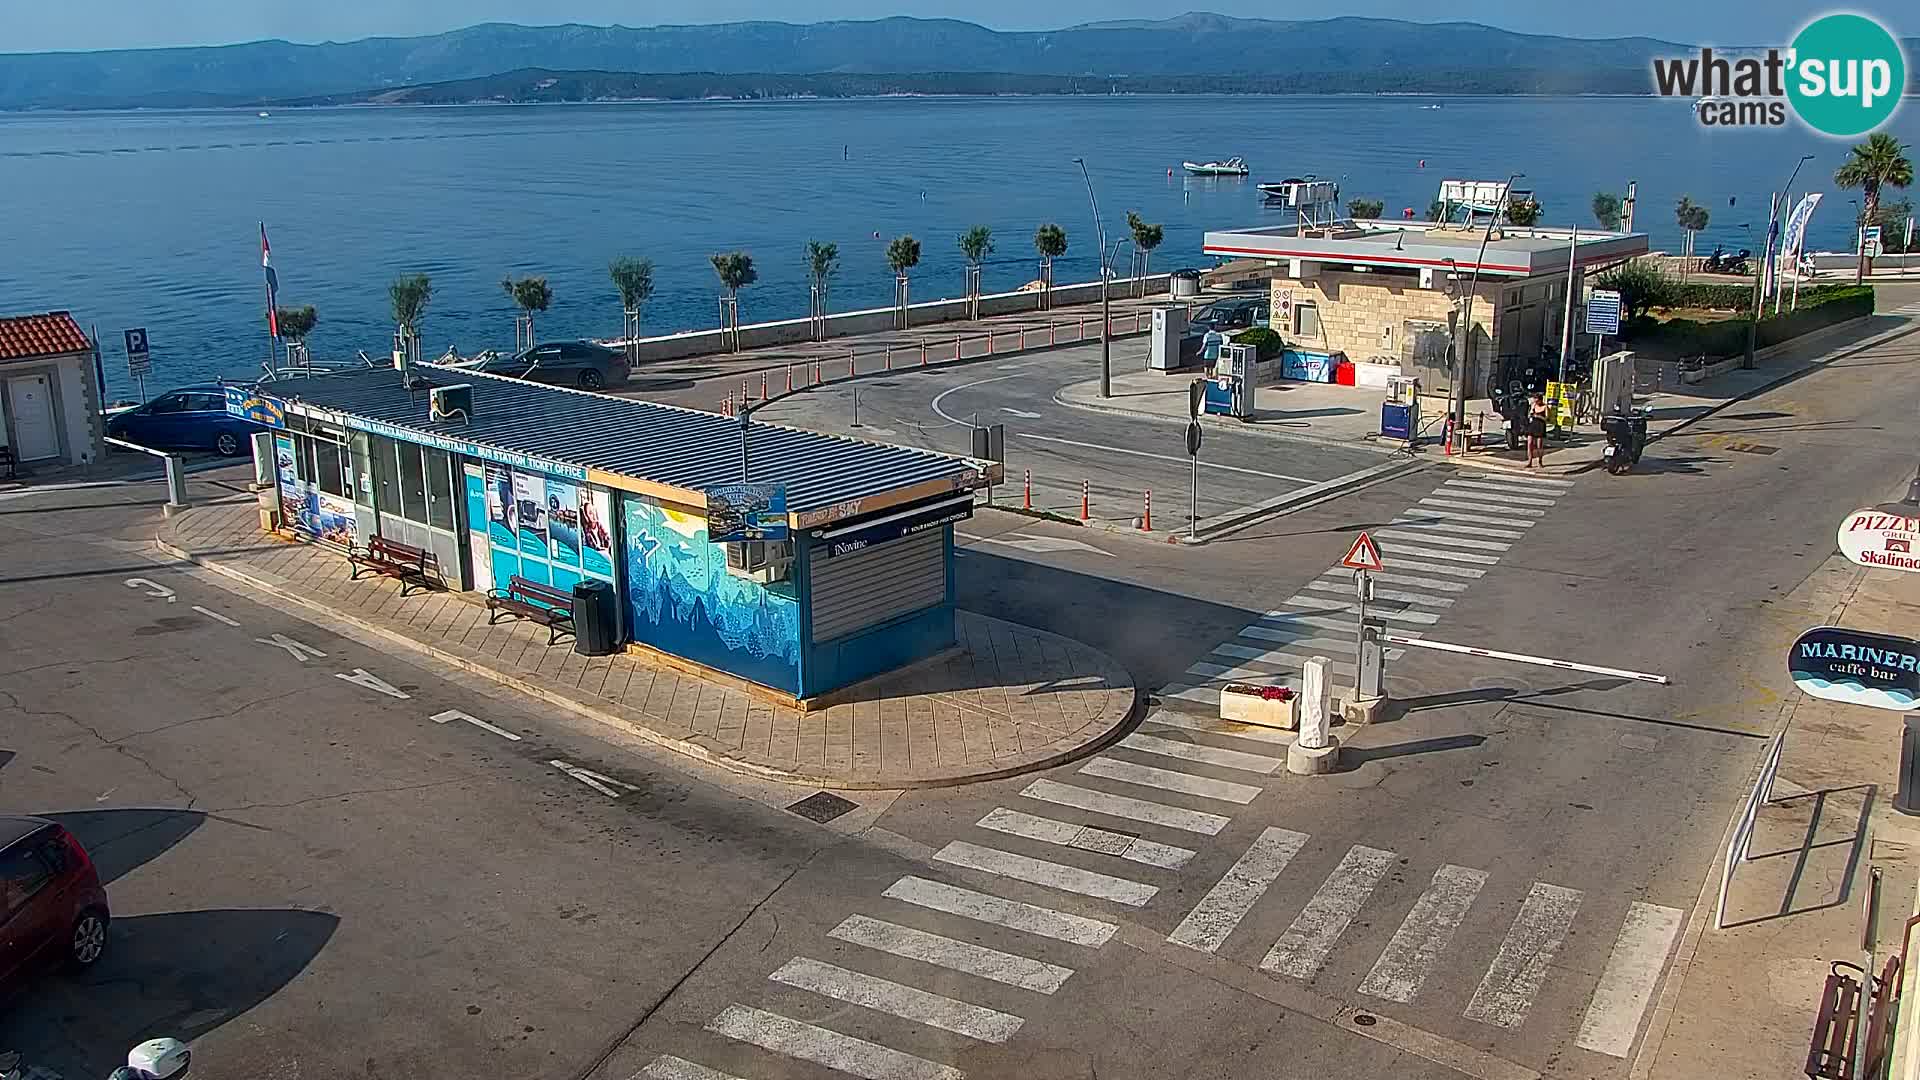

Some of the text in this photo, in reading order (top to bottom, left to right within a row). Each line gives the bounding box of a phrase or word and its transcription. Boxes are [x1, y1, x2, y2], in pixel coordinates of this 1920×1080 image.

[436, 436, 468, 452] POSTAJA
[477, 446, 493, 459] BUS
[493, 450, 527, 466] STATION
[527, 457, 555, 471] TICKET
[555, 463, 583, 478] OFFICE
[1849, 515, 1920, 533] PIZZE
[1881, 530, 1917, 541] GRILL
[1829, 662, 1898, 681] caffe bar
